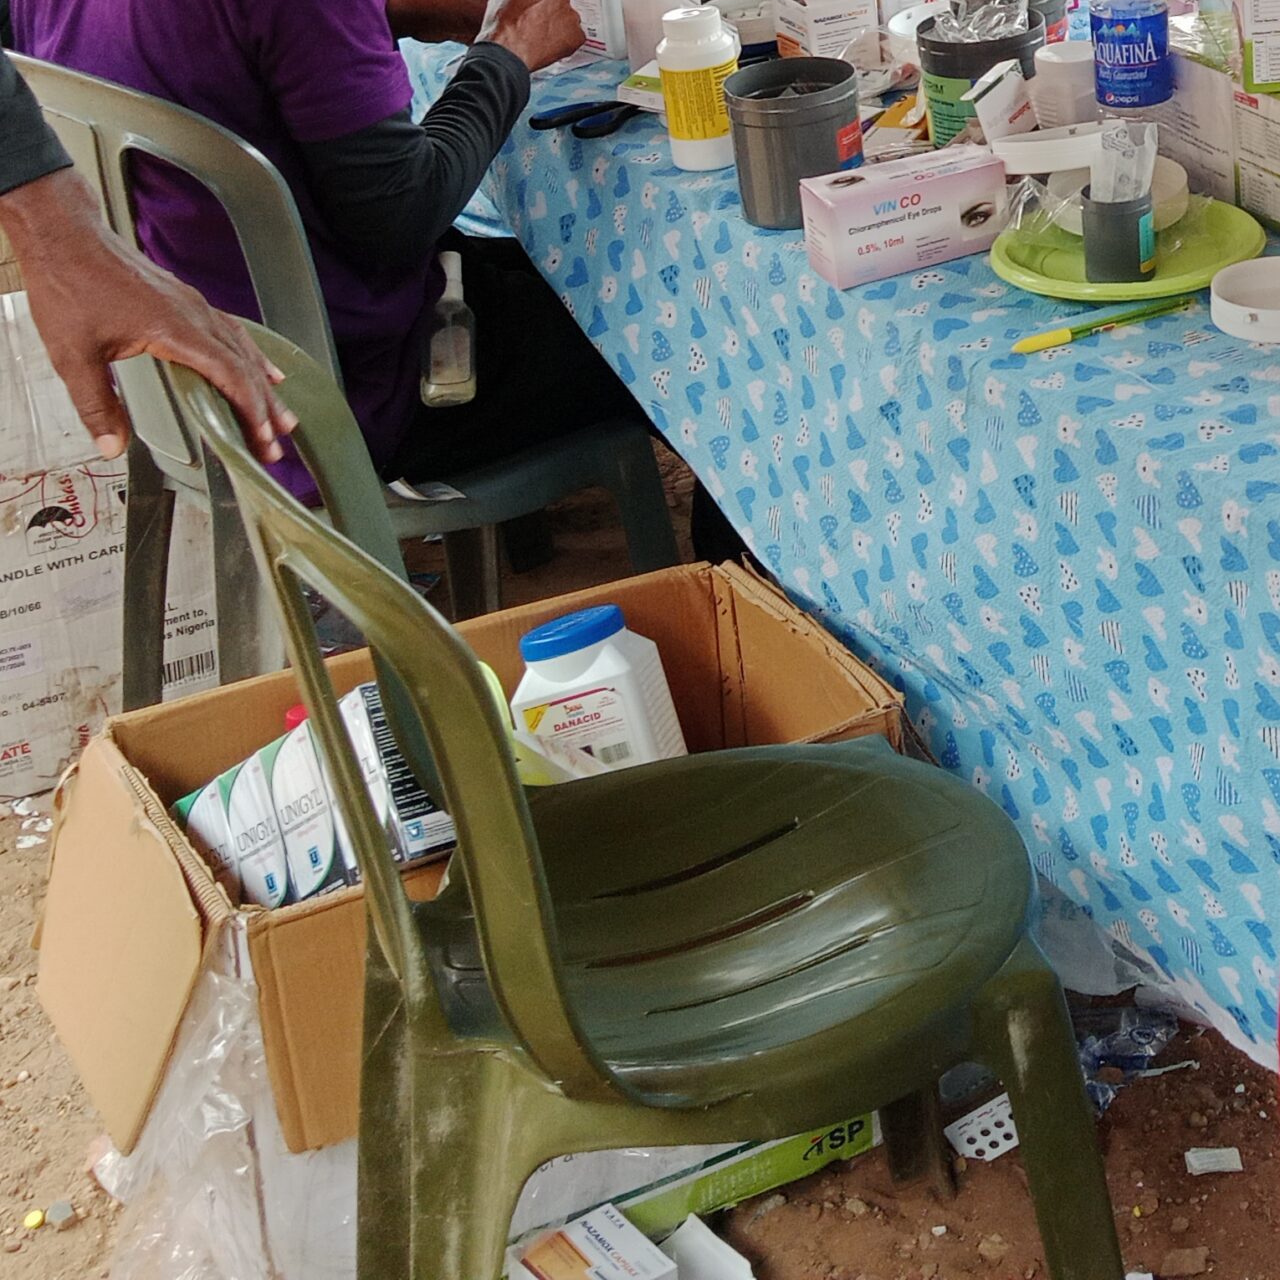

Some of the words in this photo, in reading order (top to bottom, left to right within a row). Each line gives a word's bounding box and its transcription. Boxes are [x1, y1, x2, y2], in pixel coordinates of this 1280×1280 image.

[1115, 95, 1140, 104] pepsi
[872, 200, 898, 217] VIN
[900, 193, 922, 210] CO
[907, 208, 921, 223] Eye
[922, 205, 943, 219] Drops
[46, 553, 85, 572] WITH
[175, 618, 215, 636] Nigeria
[553, 712, 602, 732] DANACID
